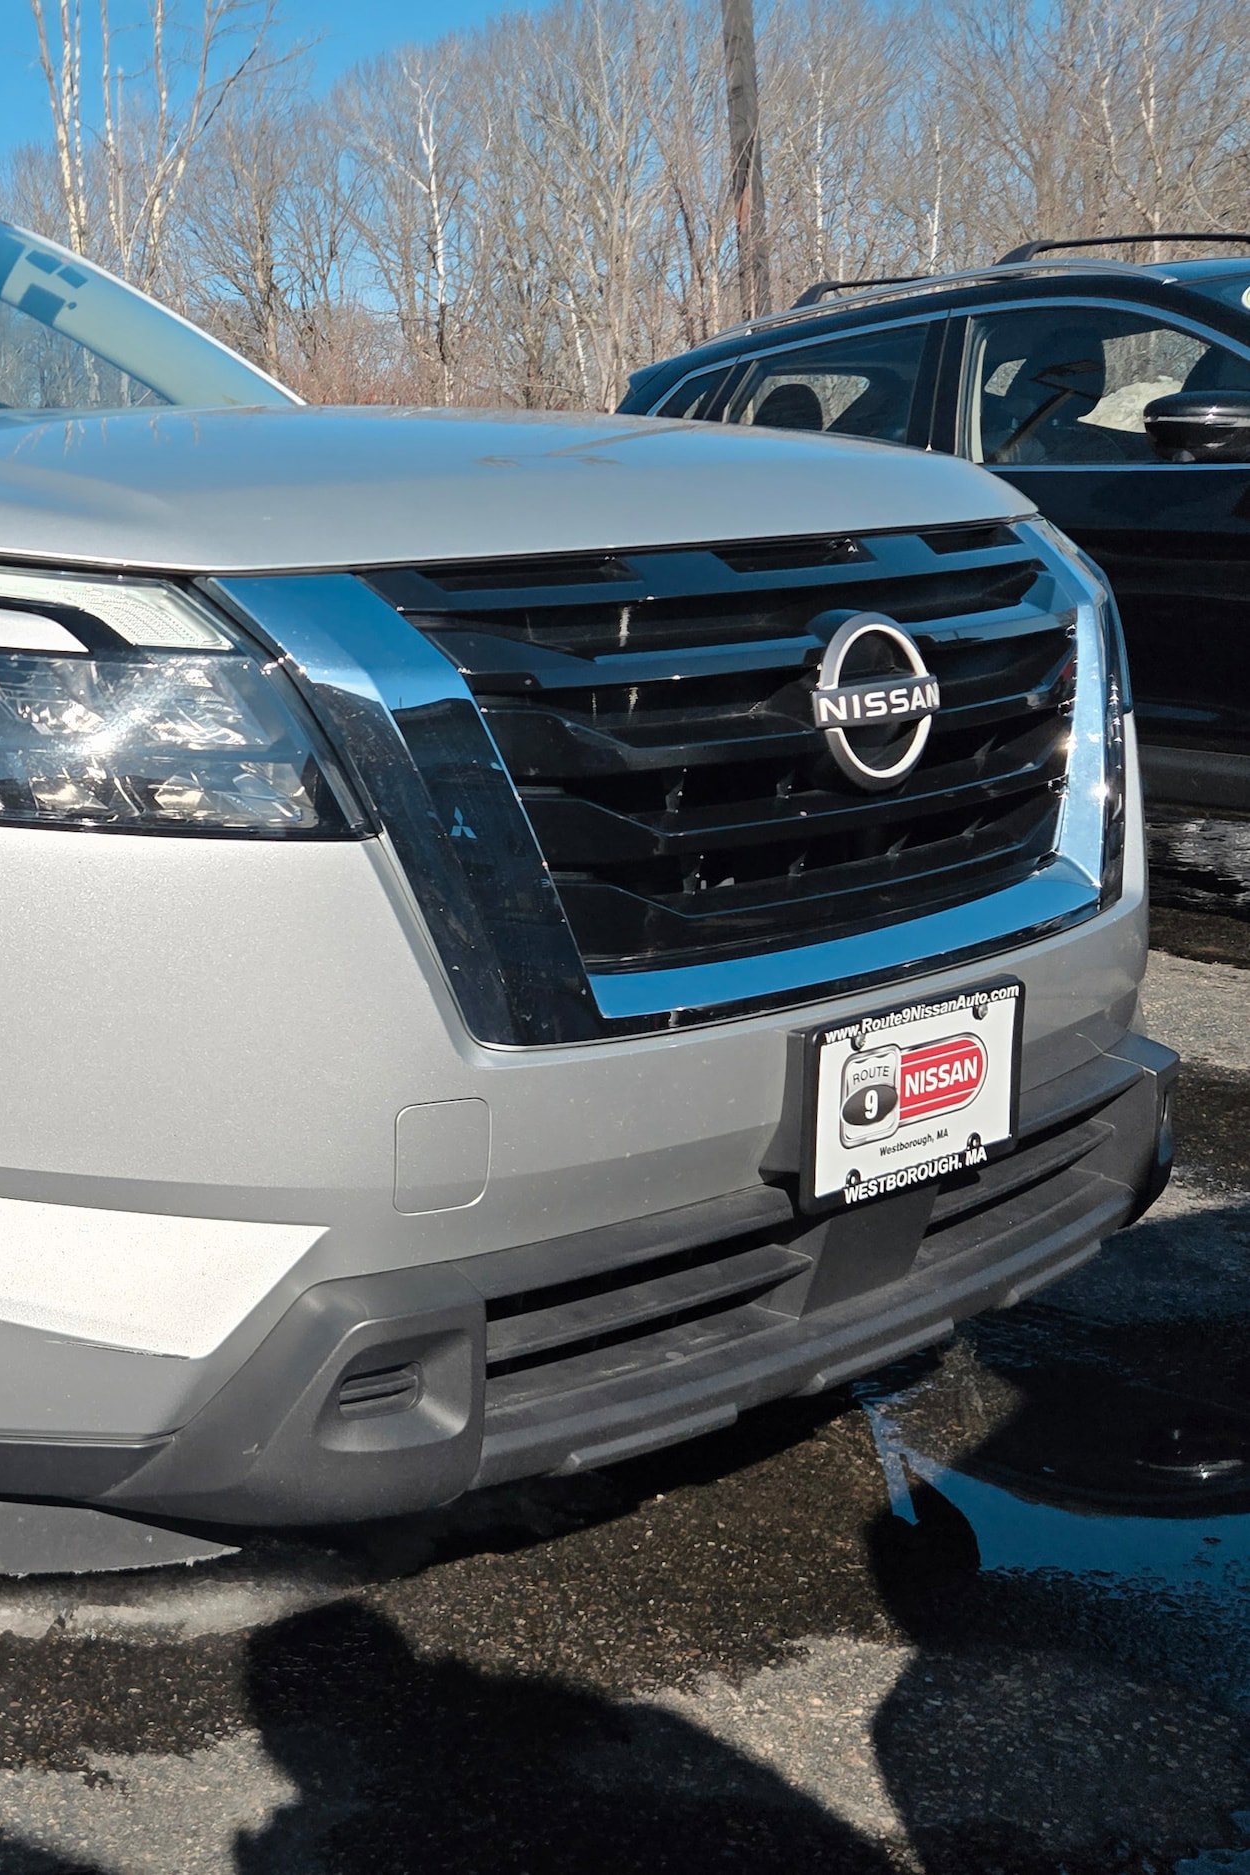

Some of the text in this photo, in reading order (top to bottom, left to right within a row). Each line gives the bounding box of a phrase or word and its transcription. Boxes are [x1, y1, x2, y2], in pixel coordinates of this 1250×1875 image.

[818, 681, 941, 722] NISSAN
[824, 984, 1020, 1045] www.Route9NissanAuto.com
[852, 1065, 890, 1083] ROUTE
[904, 1056, 978, 1098] NISSAN
[864, 1089, 879, 1120] 9
[879, 1128, 949, 1157] Westborough, MA
[965, 1146, 988, 1167] MA
